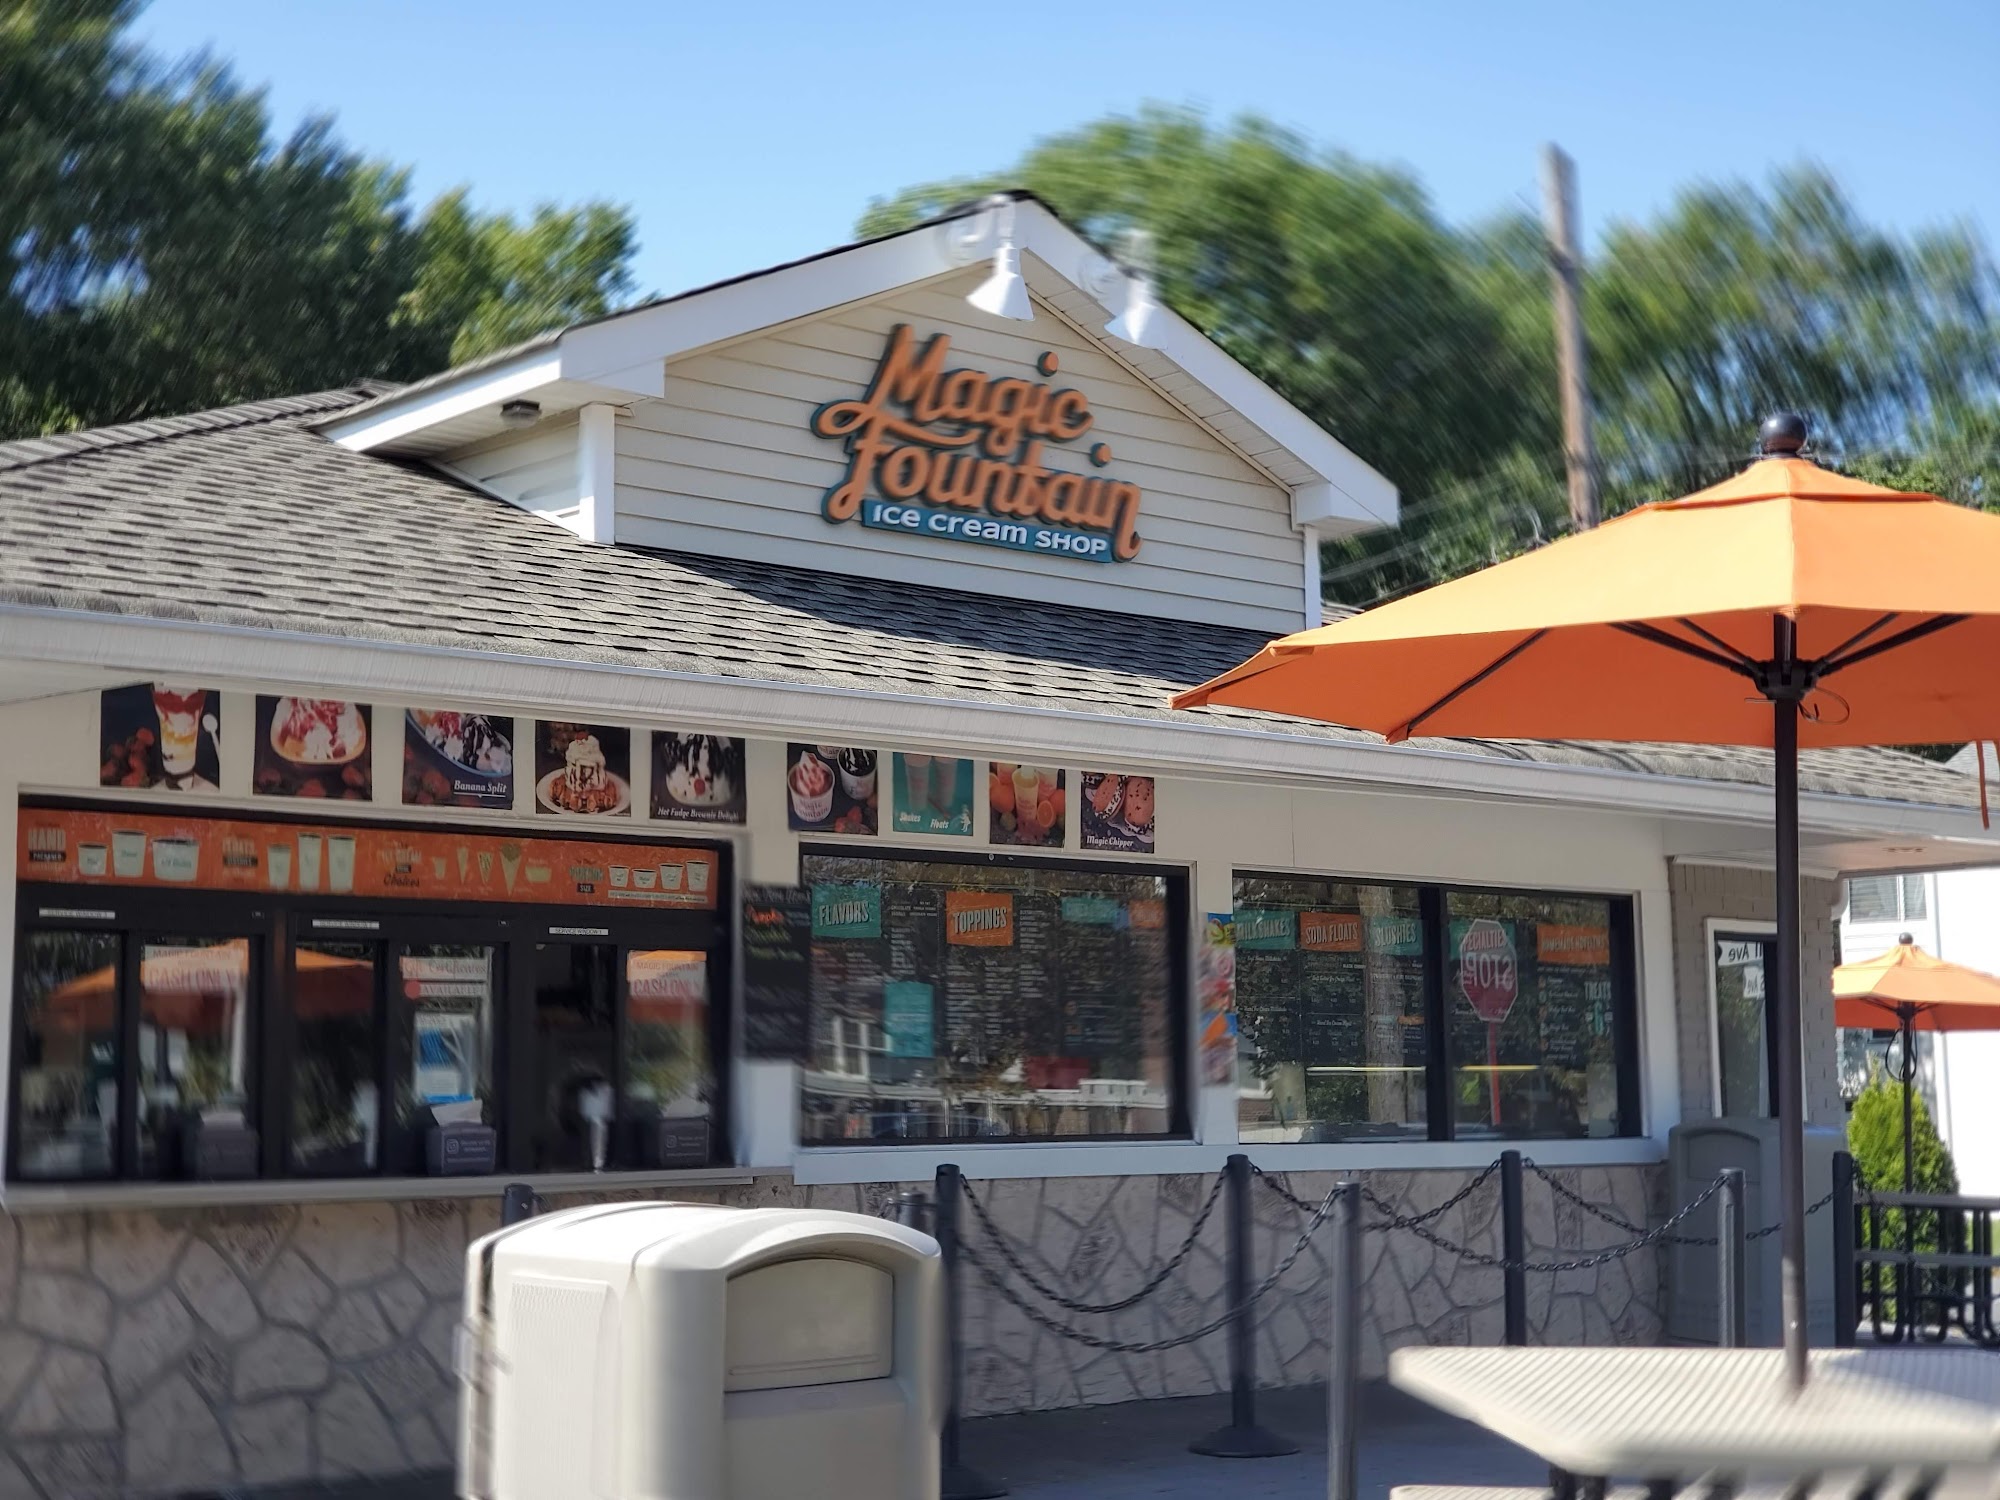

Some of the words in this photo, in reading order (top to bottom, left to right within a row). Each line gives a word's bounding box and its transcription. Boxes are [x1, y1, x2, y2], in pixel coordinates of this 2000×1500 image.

[811, 323, 1093, 457] Magic
[821, 438, 1143, 562] Fountain
[872, 504, 920, 528] Ice
[1034, 530, 1109, 556] SHOP
[454, 780, 486, 792] Banana
[487, 781, 507, 795] Split
[670, 807, 690, 819] Fudge
[691, 808, 716, 820] Brownie
[899, 811, 922, 823] Shakes
[930, 818, 950, 829] Floats
[1086, 835, 1109, 847] Magic
[1109, 837, 1134, 848] Chipper
[383, 873, 420, 887] Choices
[820, 901, 870, 926] FLAVORS
[953, 907, 1008, 934] TOPPINGS
[1306, 926, 1328, 945] SODA
[1328, 922, 1358, 943] FLOATS
[1375, 923, 1417, 947] SLUSHIES
[636, 961, 661, 970] MAGIC
[633, 979, 667, 995] CASH
[1584, 981, 1611, 1001] TREATS
